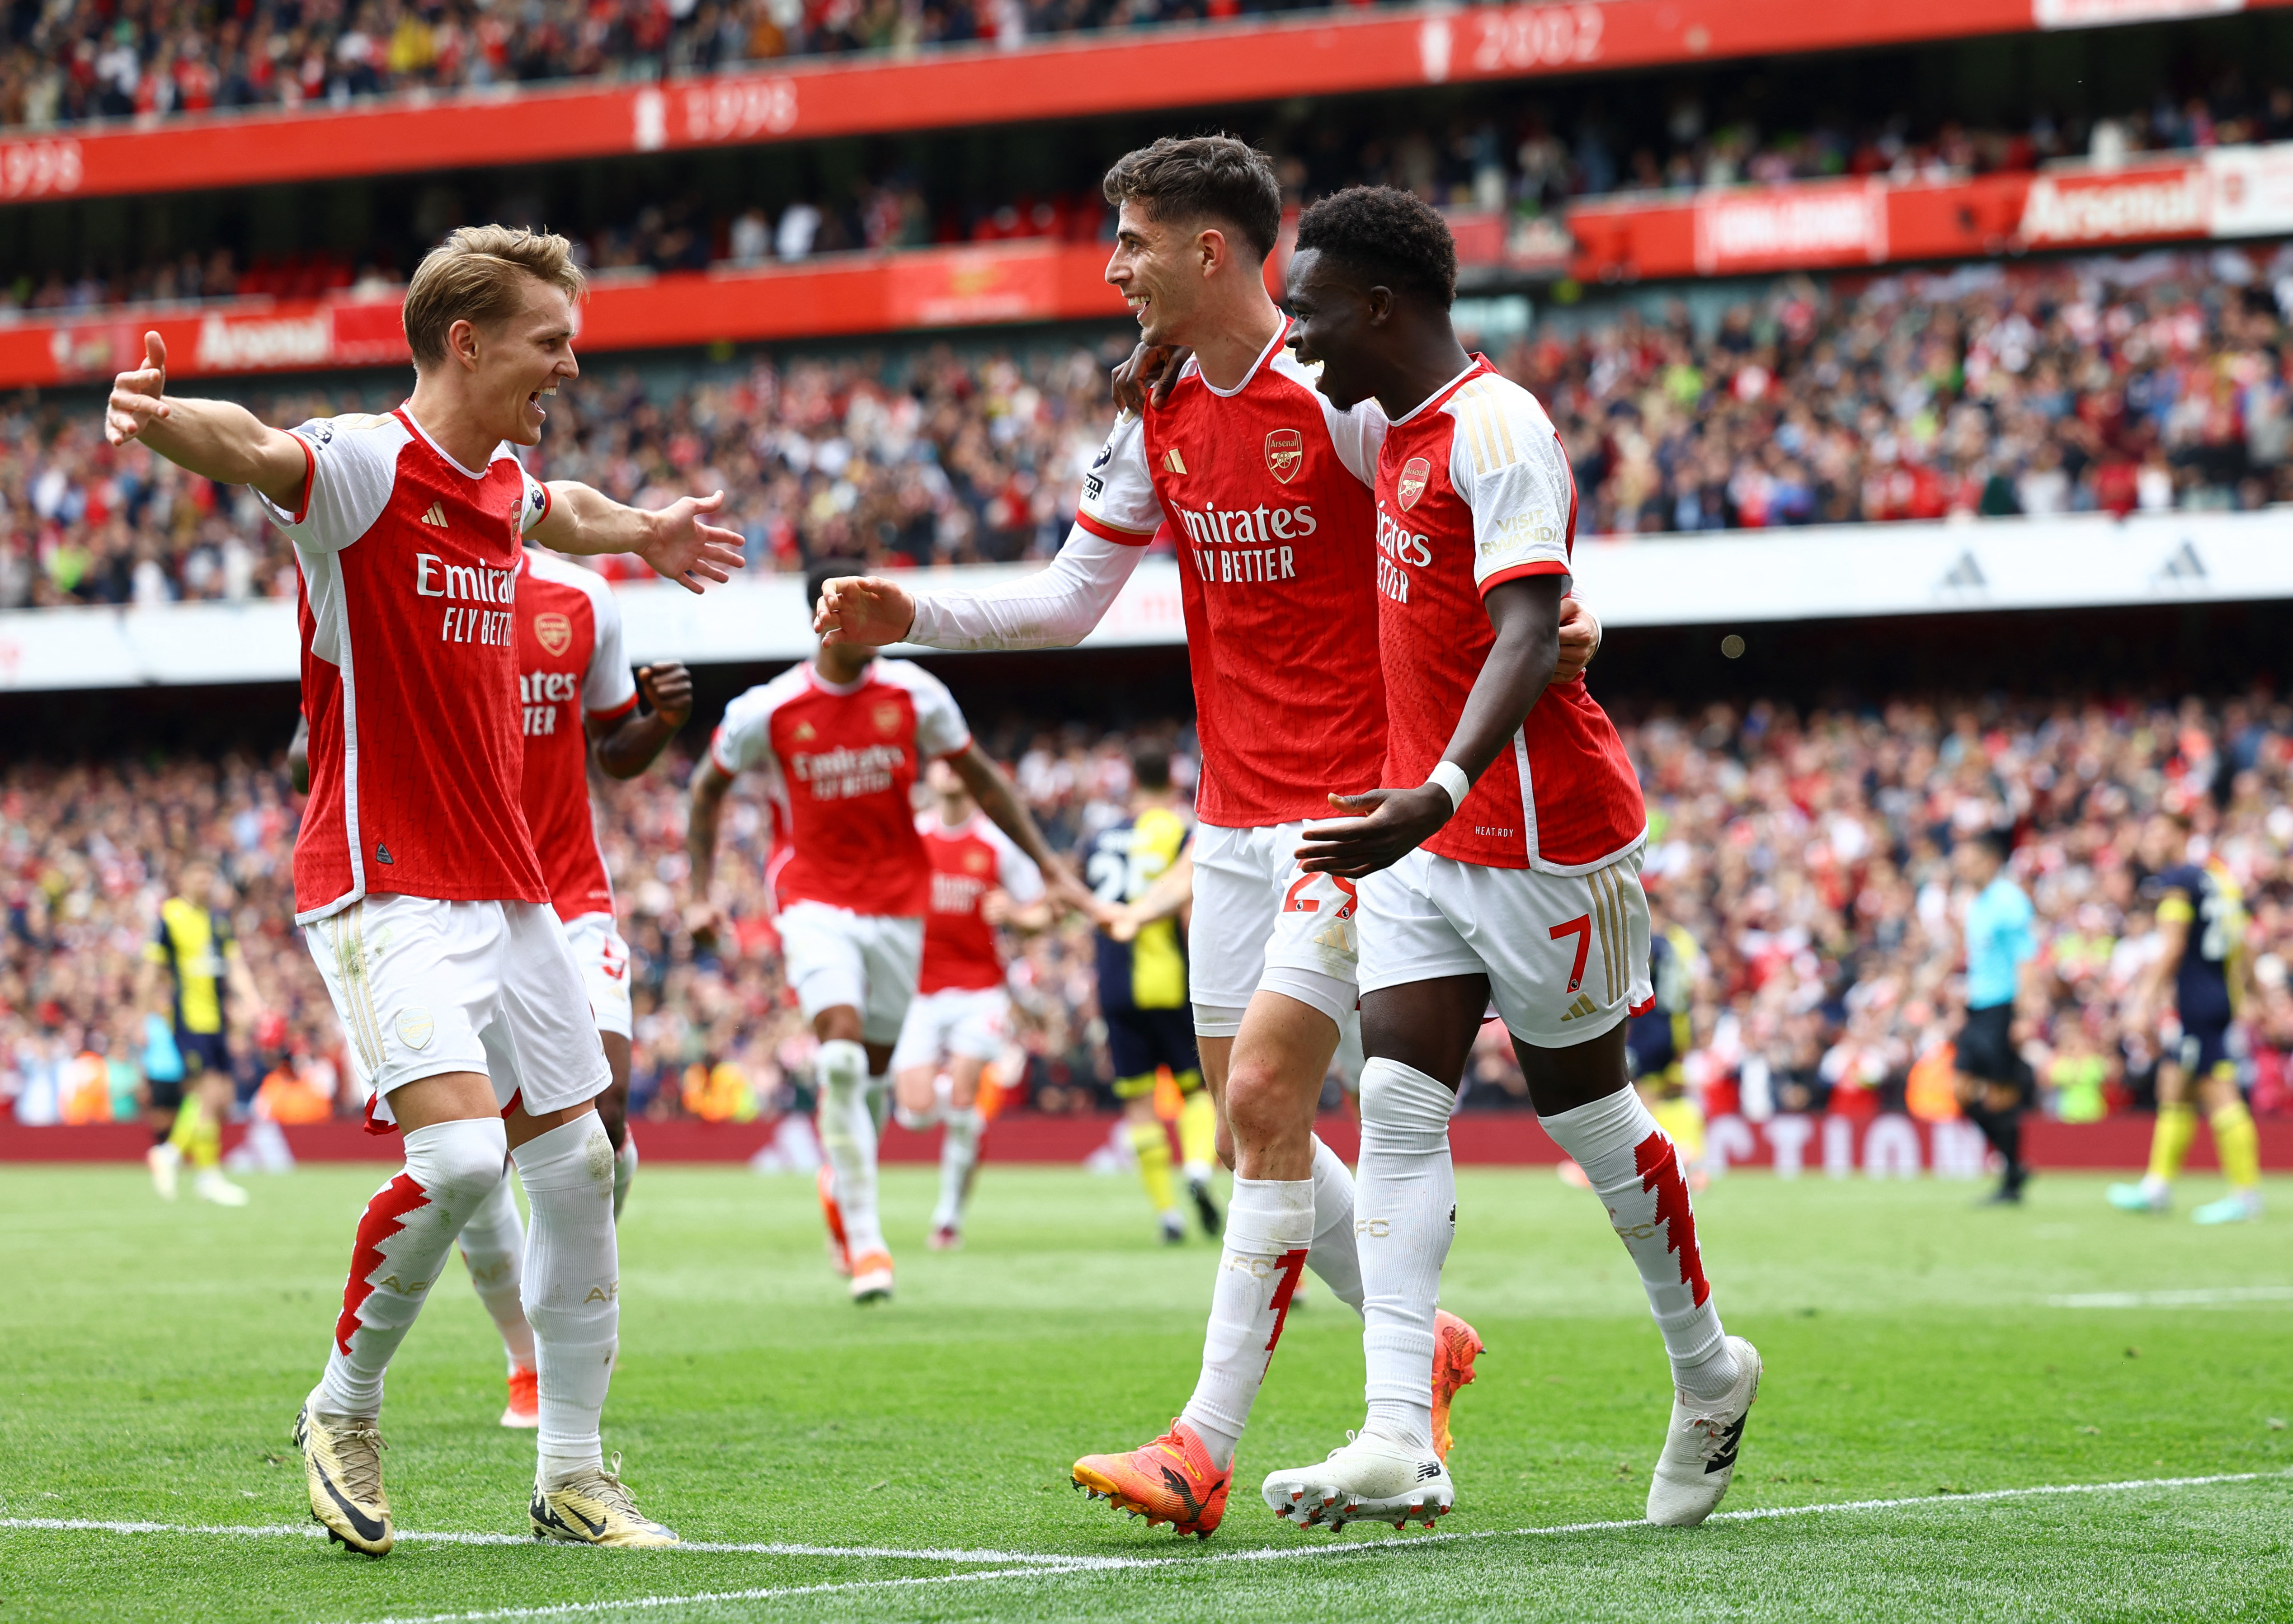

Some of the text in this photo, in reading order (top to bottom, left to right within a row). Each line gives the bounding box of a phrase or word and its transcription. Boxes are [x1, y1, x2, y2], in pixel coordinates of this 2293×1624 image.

[1271, 438, 1296, 448] Arsenal
[1406, 466, 1425, 476] Arsenal
[1496, 509, 1544, 533] VISIT
[1221, 546, 1295, 582] BETTER
[1378, 552, 1408, 603] ETTER
[442, 607, 478, 643] FLY
[1475, 826, 1513, 838] HEAT.RDY
[1548, 913, 1591, 994] 7
[1354, 1219, 1389, 1239] FC
[1615, 1223, 1655, 1240] FC
[583, 1280, 619, 1304] AF
